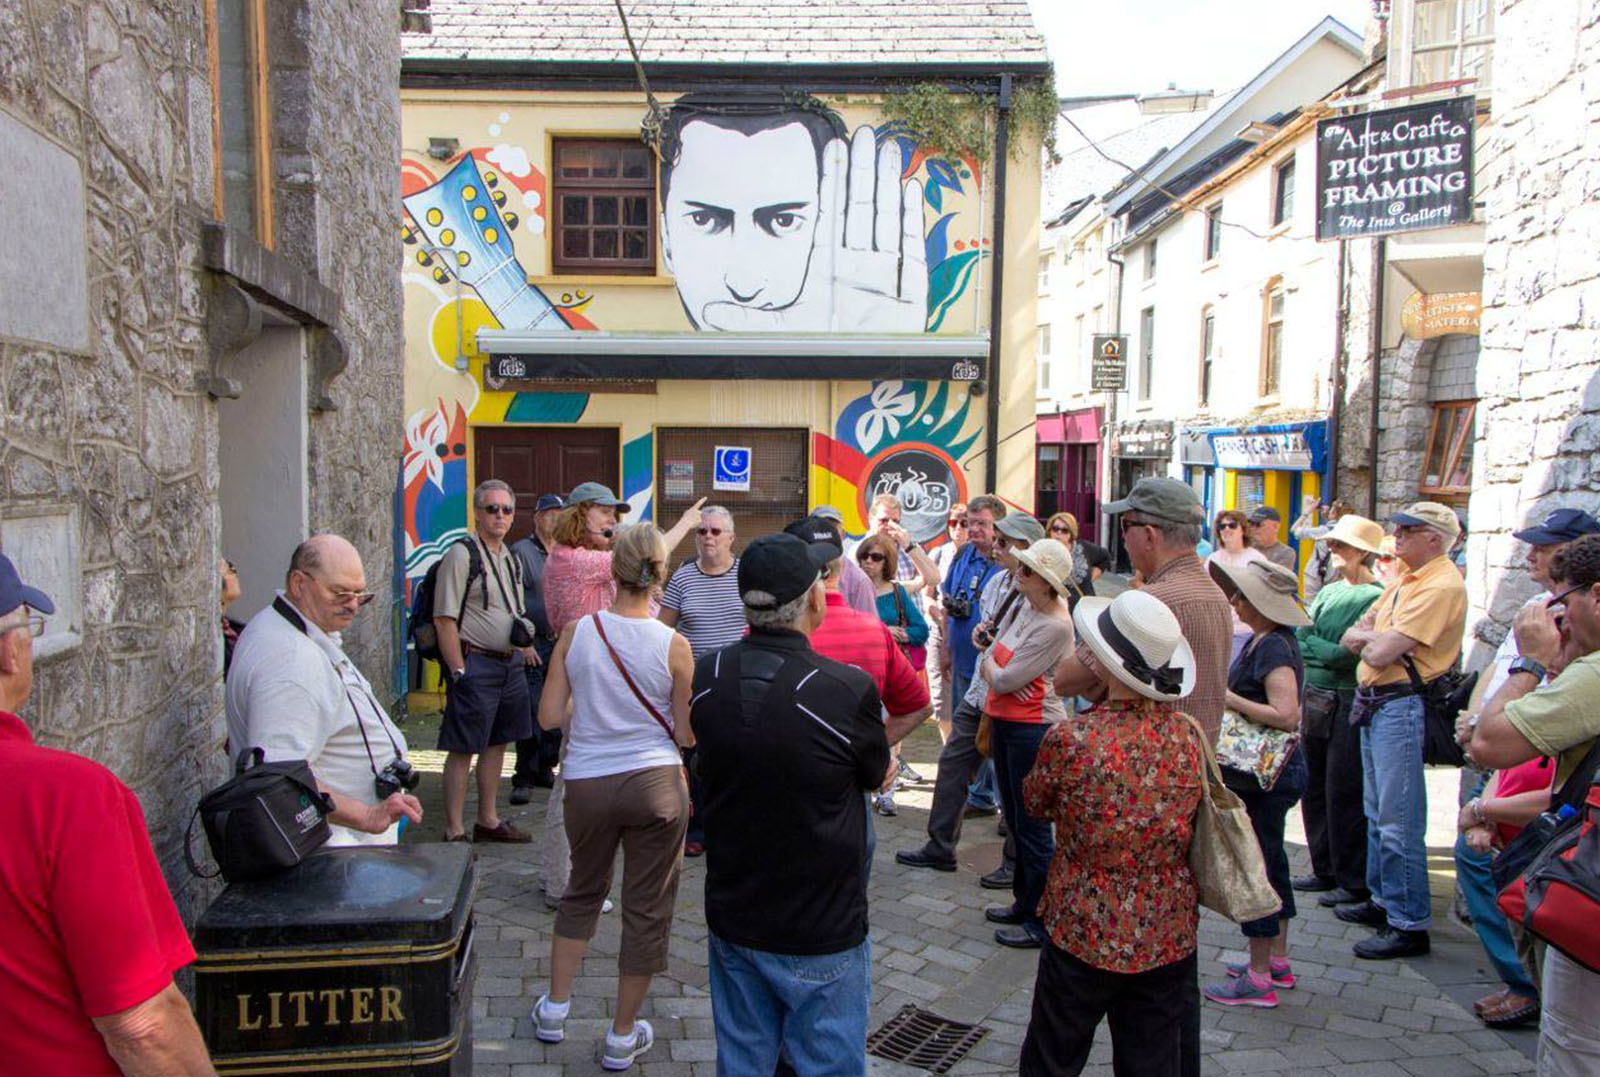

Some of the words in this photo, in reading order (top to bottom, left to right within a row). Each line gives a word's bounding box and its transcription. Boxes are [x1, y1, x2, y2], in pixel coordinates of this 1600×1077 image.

[1327, 143, 1463, 181] PICTURE
[1323, 171, 1466, 208] FRAMING
[1388, 201, 1405, 215] @
[1338, 215, 1366, 228] The
[1399, 204, 1452, 225] Gallery
[237, 987, 405, 1030] LITTER
